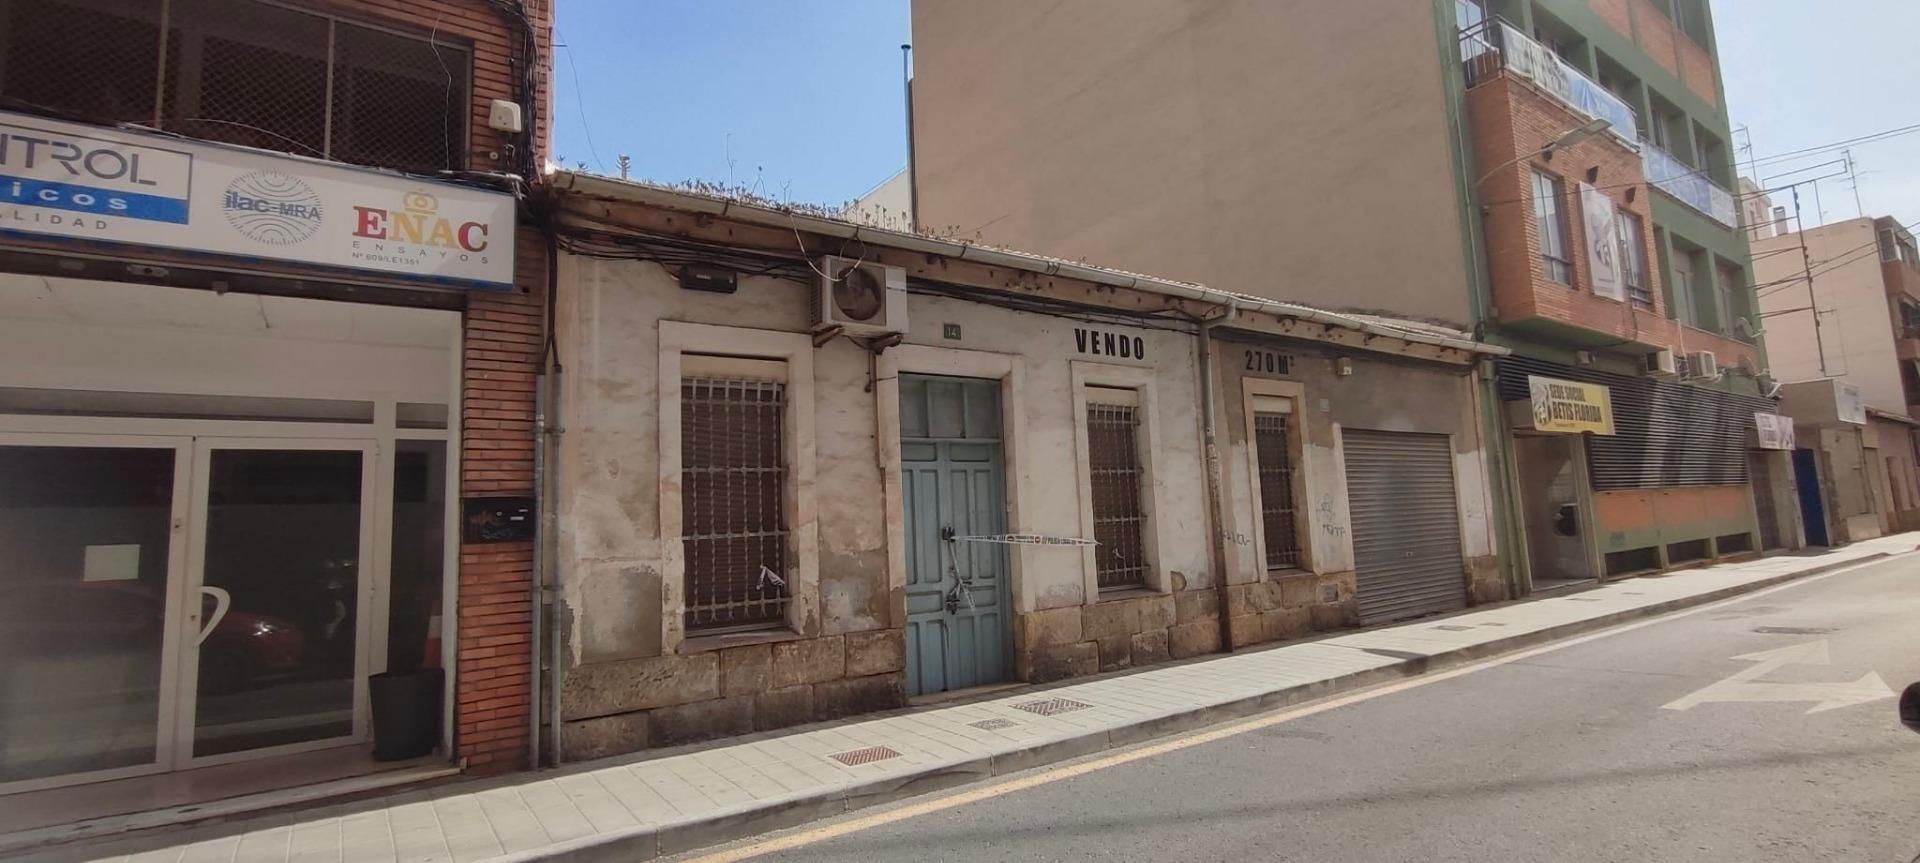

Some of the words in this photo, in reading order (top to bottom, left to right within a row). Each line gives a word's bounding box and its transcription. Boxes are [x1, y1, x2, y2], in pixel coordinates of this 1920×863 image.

[0, 133, 157, 186] TROL
[0, 210, 107, 230] LIDAD
[352, 205, 488, 252] ENAC
[352, 241, 489, 264] ENSAYOS
[1075, 328, 1145, 360] VENDO
[1549, 384, 1565, 399] SEDE
[1552, 401, 1574, 420] BETIS
[1573, 403, 1602, 422] FLORIDA
